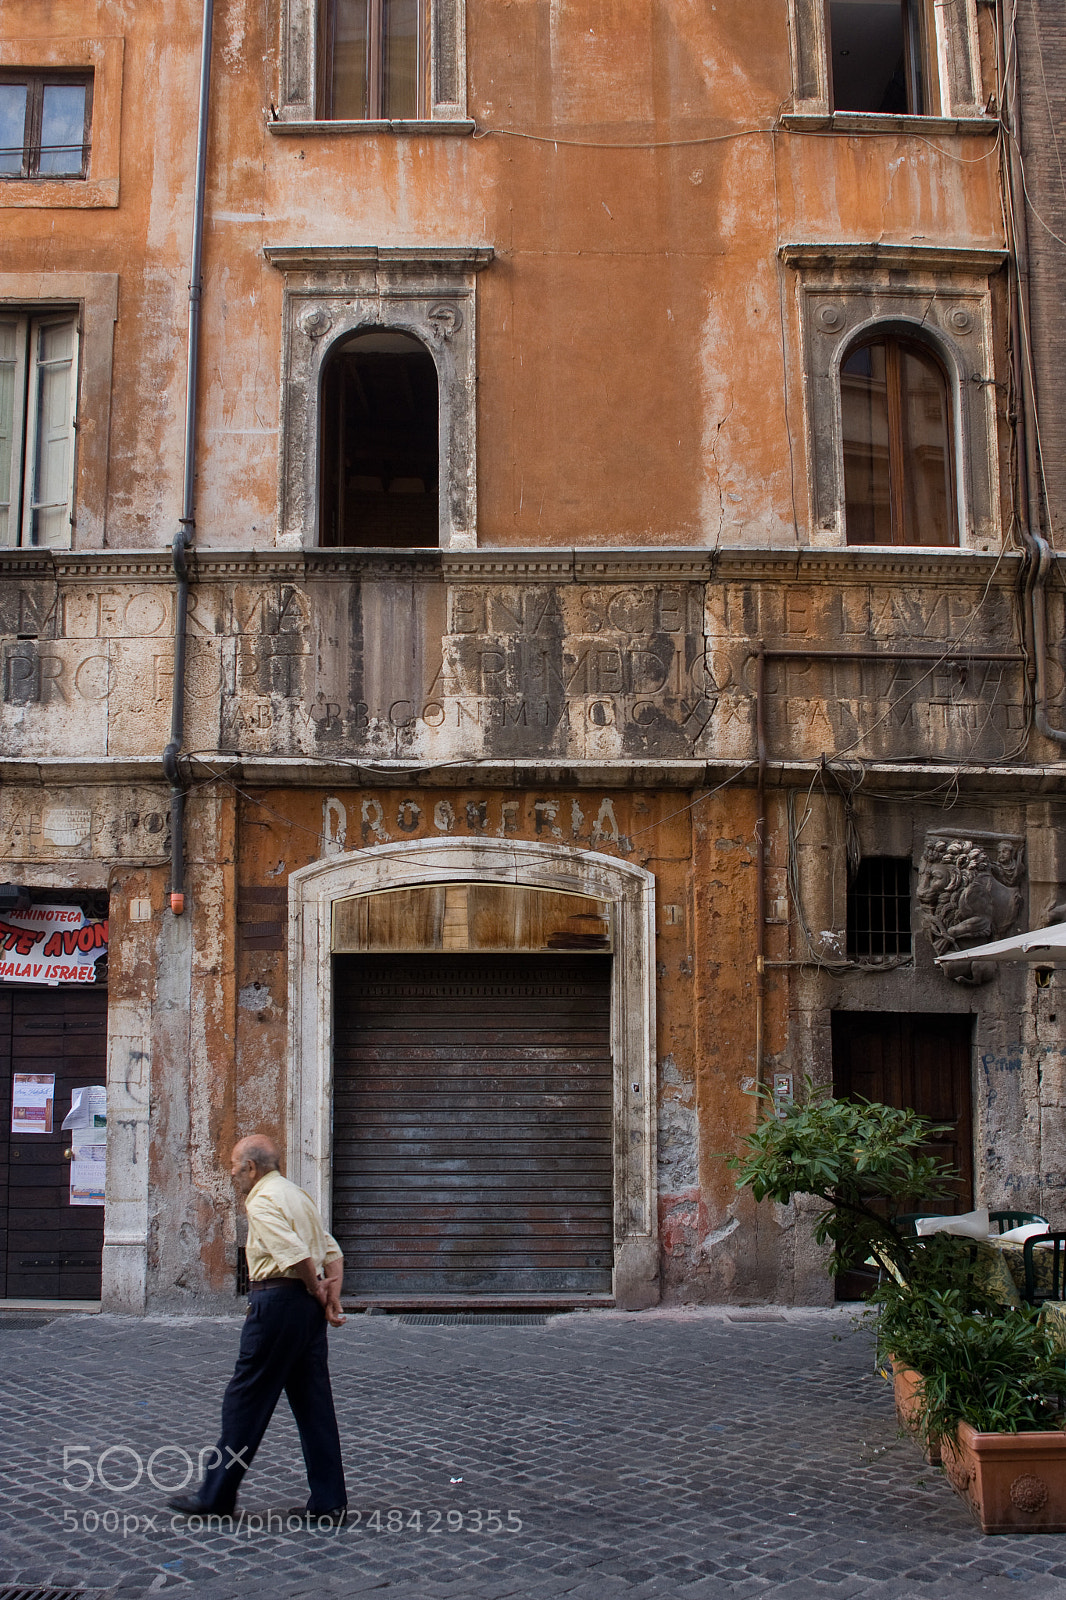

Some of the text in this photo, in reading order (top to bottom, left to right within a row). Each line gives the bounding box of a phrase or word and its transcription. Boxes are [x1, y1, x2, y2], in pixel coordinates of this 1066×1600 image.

[320, 797, 634, 855] DROGHERIA
[9, 909, 82, 923] PANINOTECA
[45, 965, 95, 980] ISRAEL
